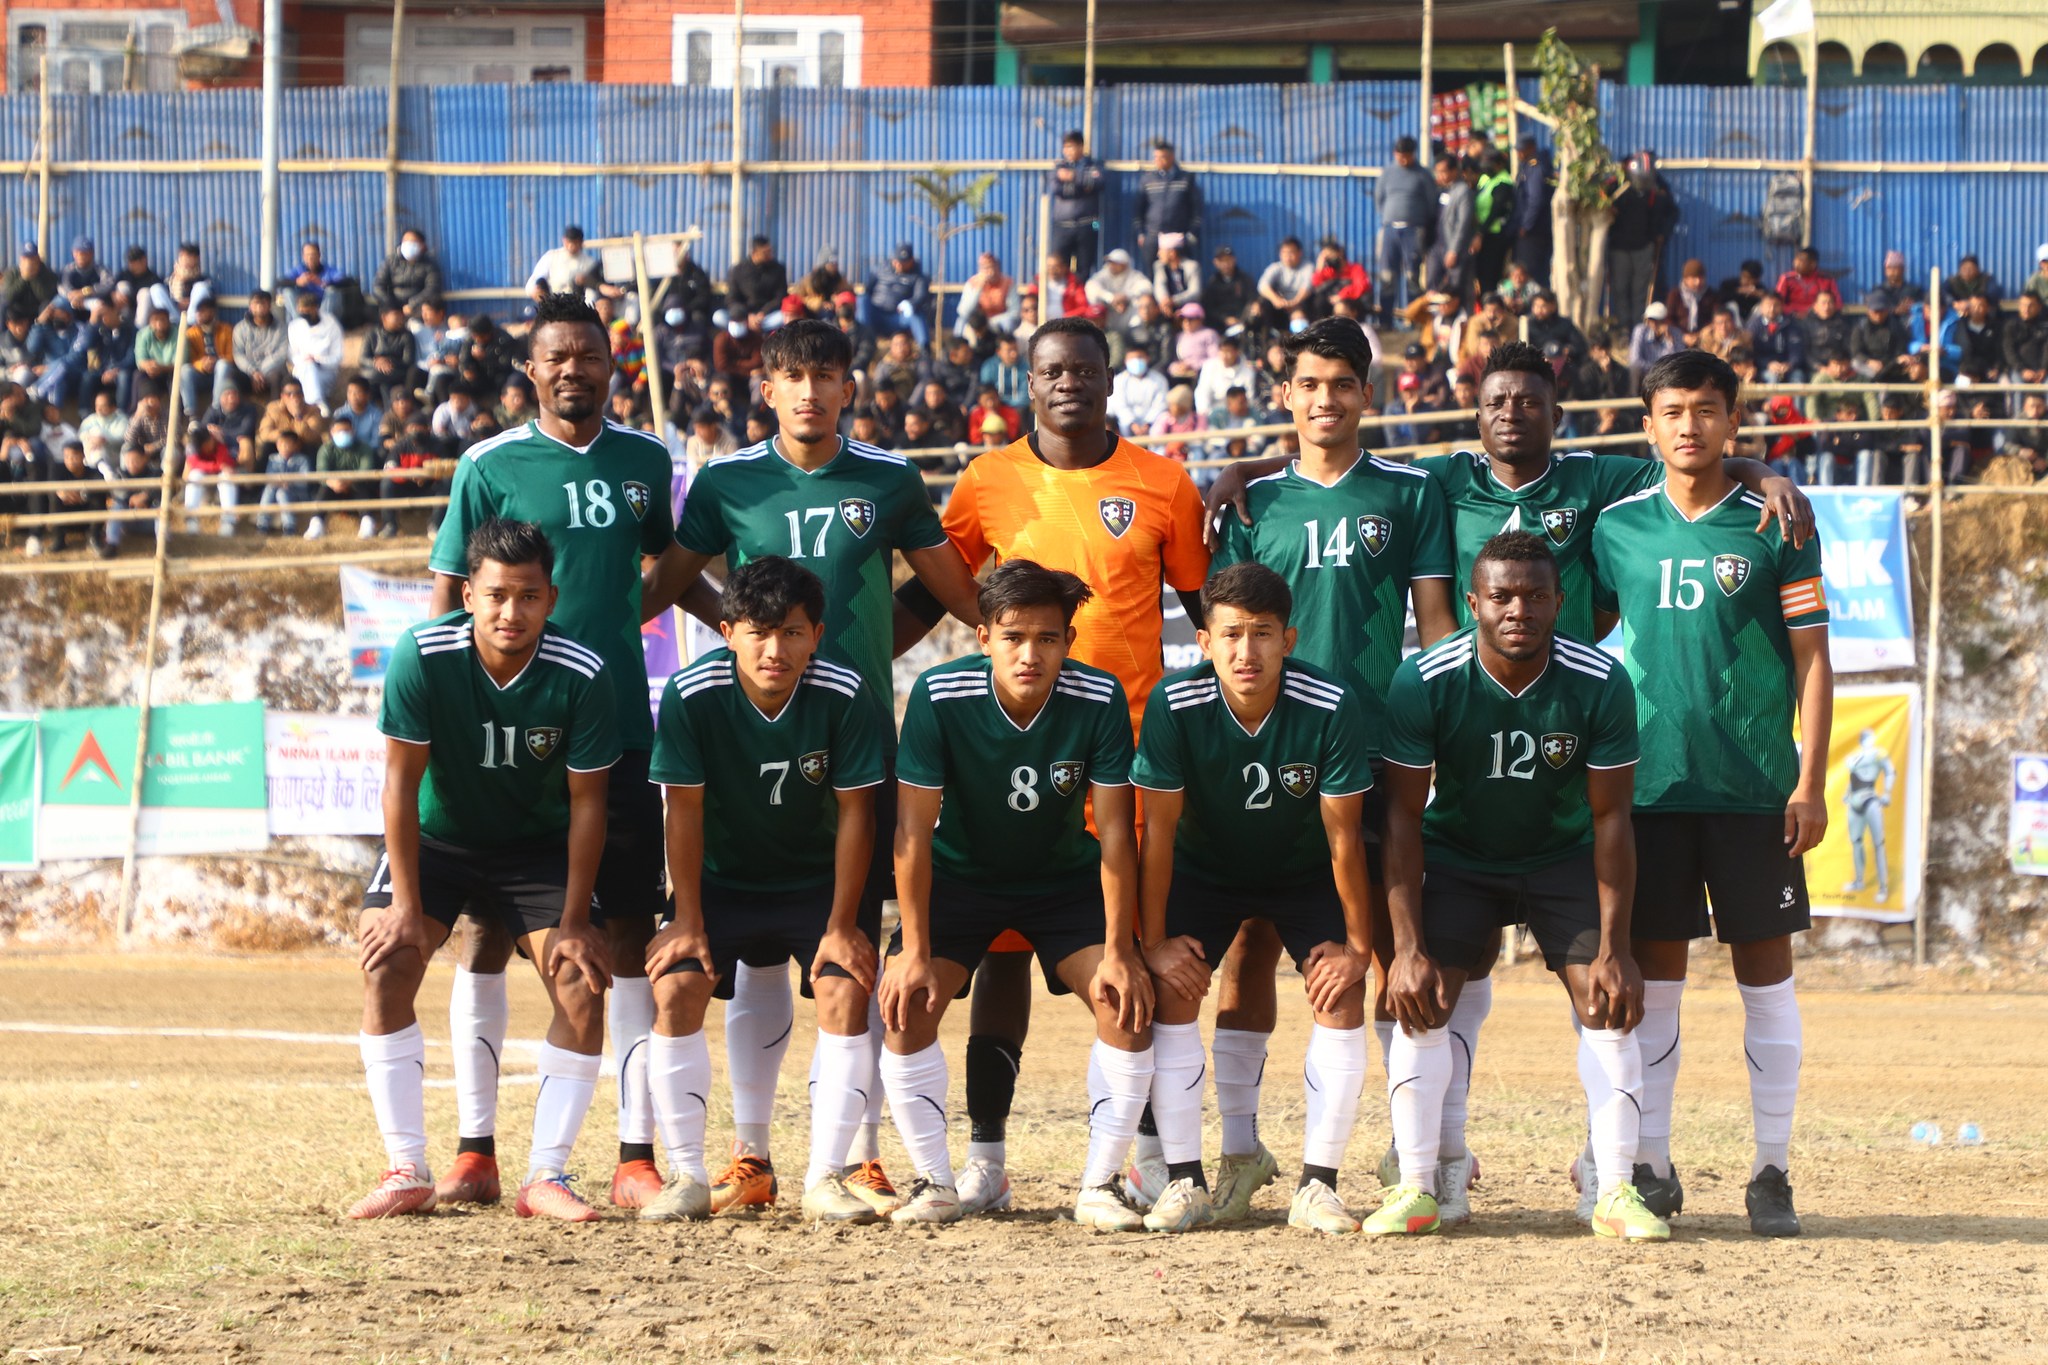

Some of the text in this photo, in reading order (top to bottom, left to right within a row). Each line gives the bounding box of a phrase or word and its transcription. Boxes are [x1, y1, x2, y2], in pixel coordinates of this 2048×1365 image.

[561, 479, 616, 529] 18
[784, 507, 835, 558] 17
[1303, 516, 1355, 568] 14
[1656, 558, 1706, 610] 15
[1821, 538, 1893, 589] NK
[191, 749, 244, 767] BANK
[479, 720, 519, 769] 11
[1486, 730, 1537, 780] 12
[759, 760, 791, 806] 7
[1007, 765, 1040, 812] 8
[1242, 762, 1273, 810] 2
